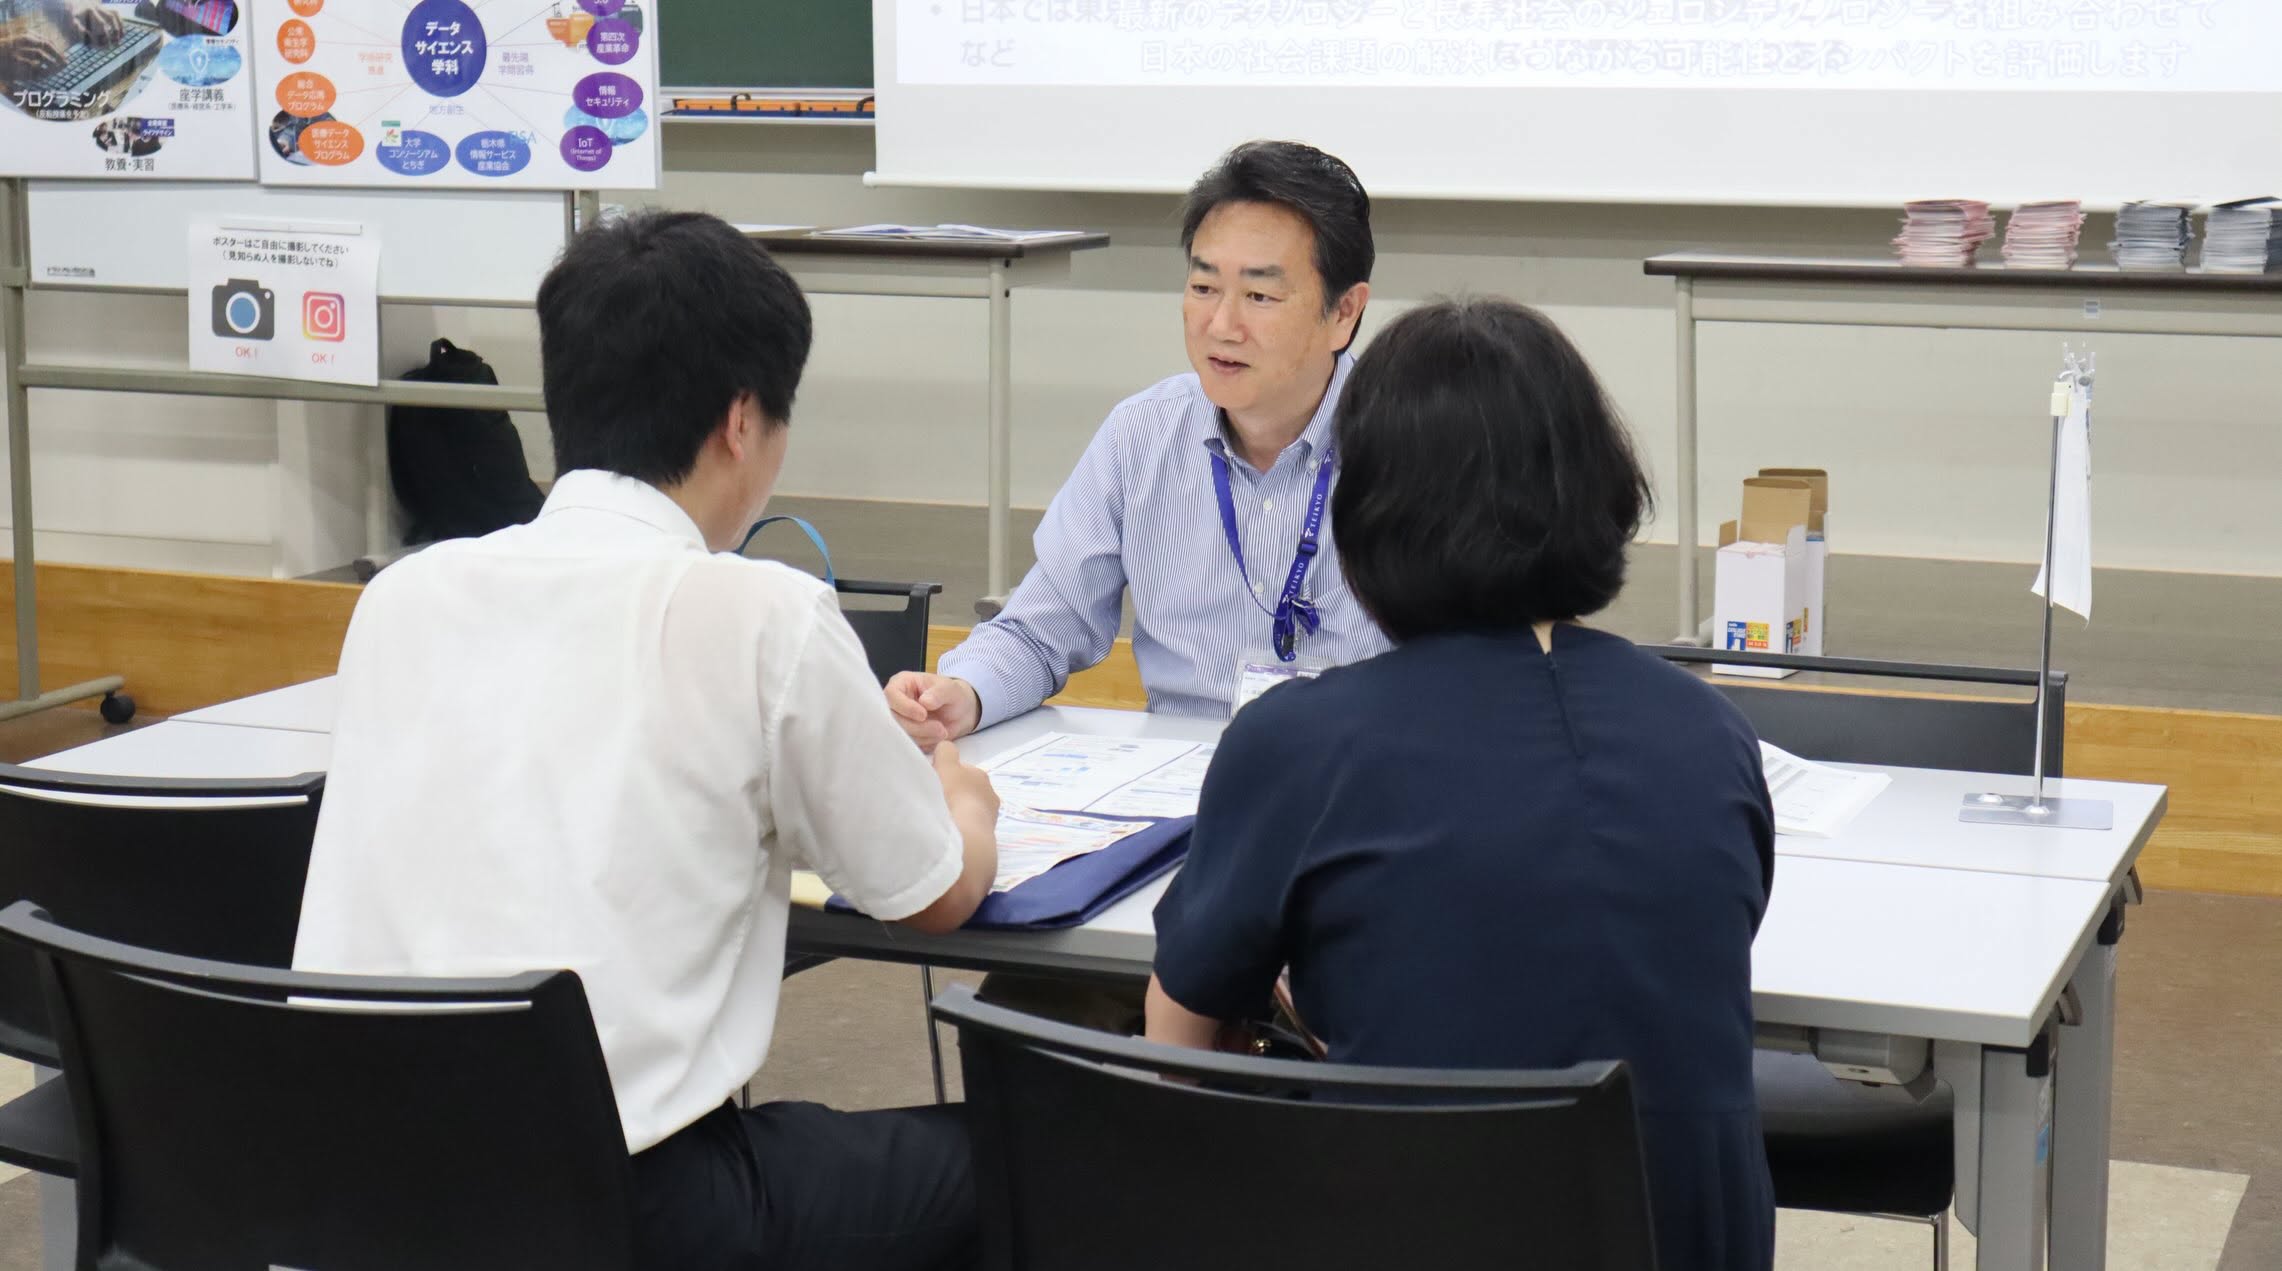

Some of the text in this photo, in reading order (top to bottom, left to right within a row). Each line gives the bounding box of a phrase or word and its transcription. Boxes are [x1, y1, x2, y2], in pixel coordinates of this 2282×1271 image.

[424, 21, 462, 37] データ
[600, 31, 626, 43] 第四次
[414, 40, 475, 56] サイエンス
[596, 43, 630, 55] 産業革命
[960, 38, 1017, 68] など
[431, 59, 460, 75] 学科
[179, 88, 226, 102] 座学講義
[598, 85, 617, 97] 情報
[13, 89, 111, 108] プログラミング
[585, 97, 630, 108] セキュリティ
[287, 101, 326, 112] プログラム
[313, 139, 349, 150] サイエンス
[404, 138, 422, 149] 大学
[578, 138, 594, 149] IoT
[313, 150, 350, 161] プログラム
[388, 149, 438, 160] コンソーシアム
[469, 149, 517, 160] 情報サービス
[105, 158, 155, 172] 教養・実習
[401, 160, 426, 171] とちぎ
[1309, 493, 1323, 528] TEIKYO
[1288, 562, 1305, 594] TEIKYO
